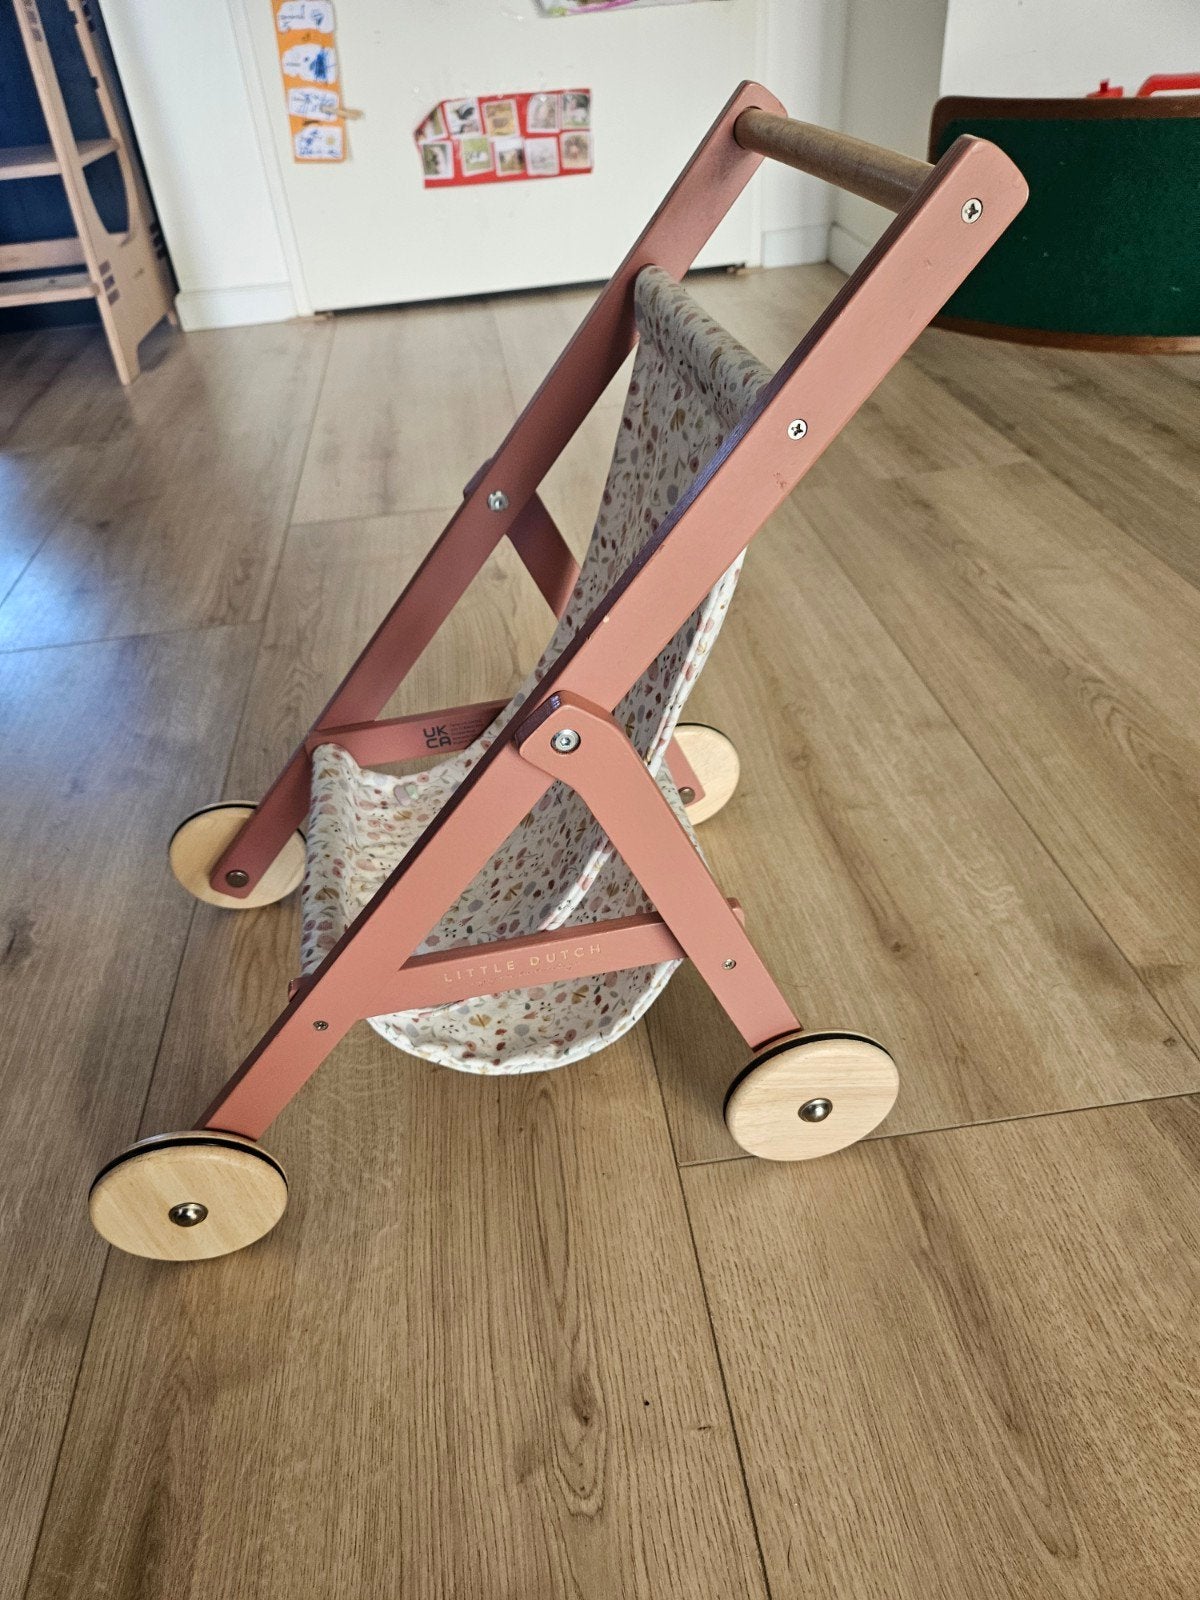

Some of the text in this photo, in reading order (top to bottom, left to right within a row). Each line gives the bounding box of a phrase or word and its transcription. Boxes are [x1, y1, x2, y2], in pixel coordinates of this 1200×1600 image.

[423, 725, 448, 738] UK
[426, 736, 451, 749] CA
[443, 960, 516, 983] LITTLE
[529, 943, 601, 967] DUTCH
